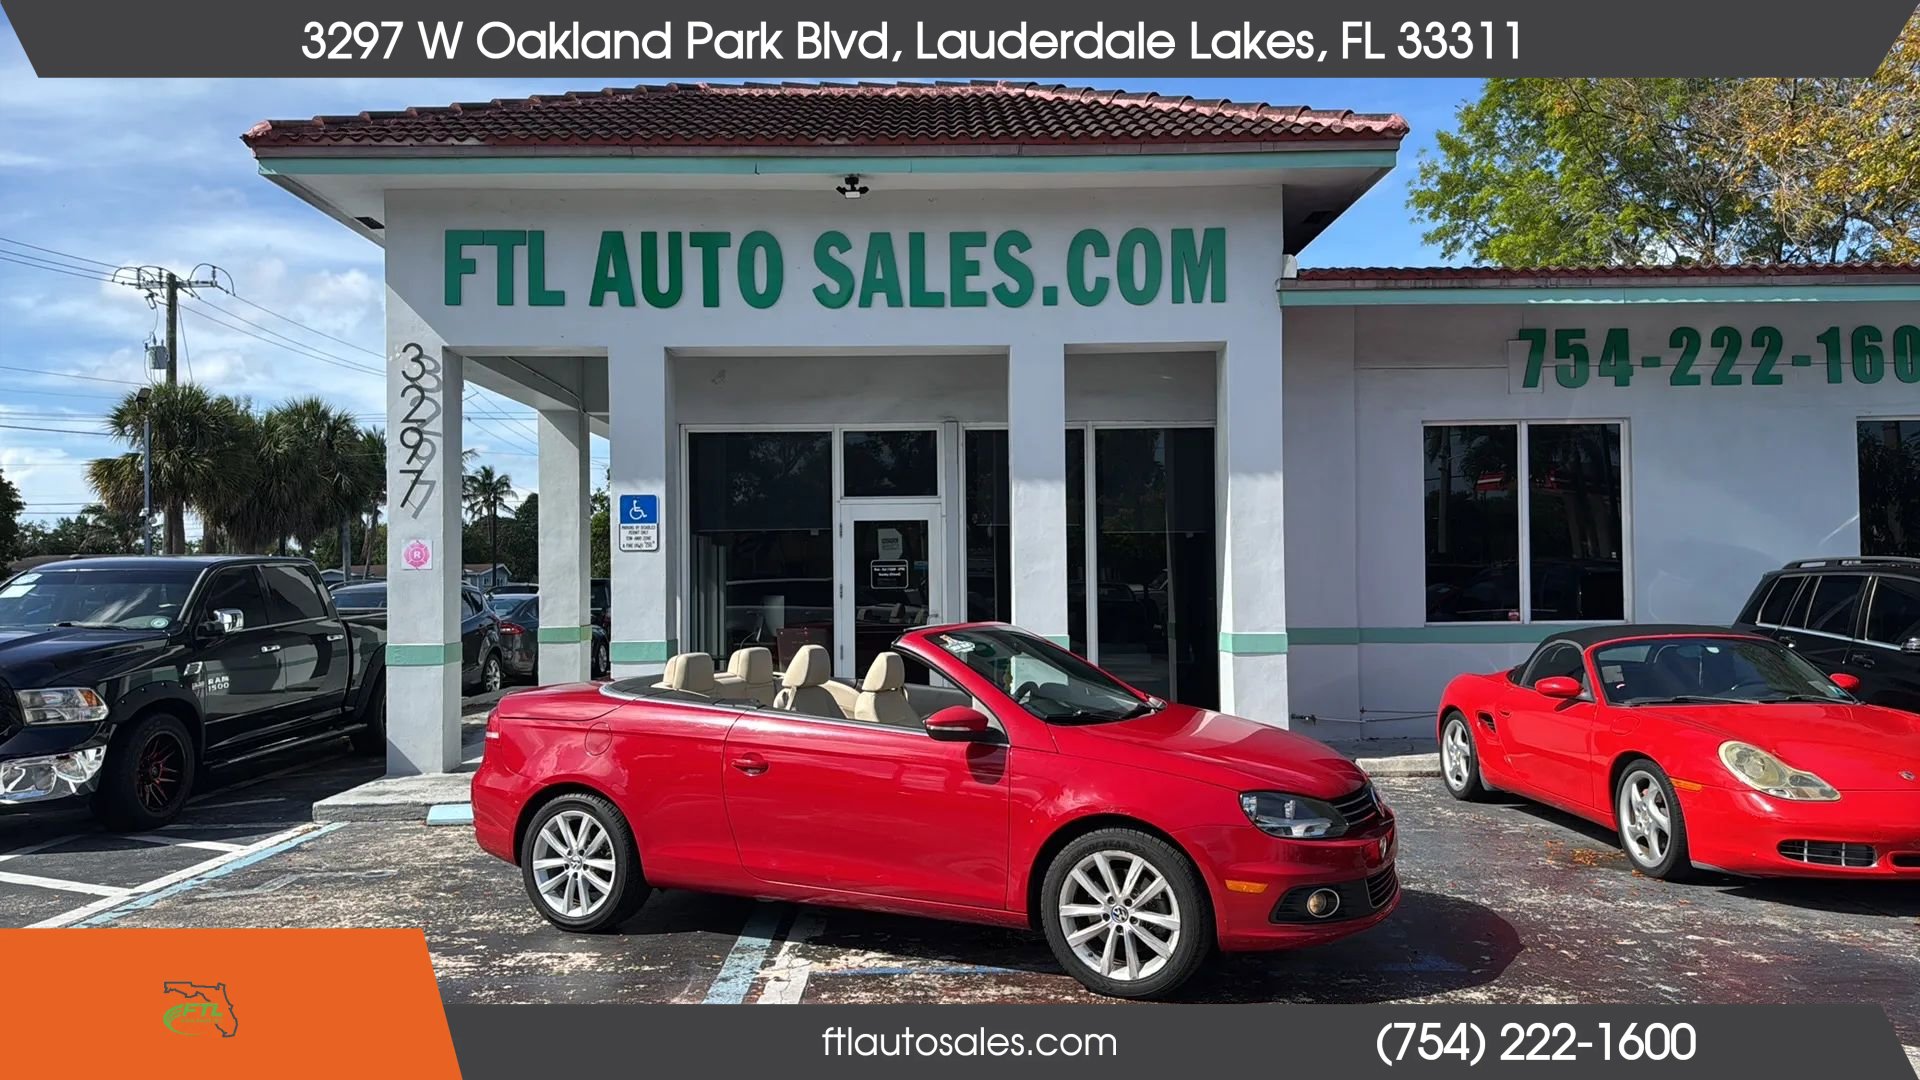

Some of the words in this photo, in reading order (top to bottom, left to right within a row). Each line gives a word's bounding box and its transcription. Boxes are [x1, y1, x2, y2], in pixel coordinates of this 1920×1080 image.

[444, 229, 565, 307] FTL
[590, 230, 784, 309] AUTO
[812, 227, 1227, 309] SALES.COM
[399, 342, 426, 509] 3297
[413, 550, 422, 560] R
[208, 676, 229, 686] RAM
[208, 682, 230, 693] 1500
